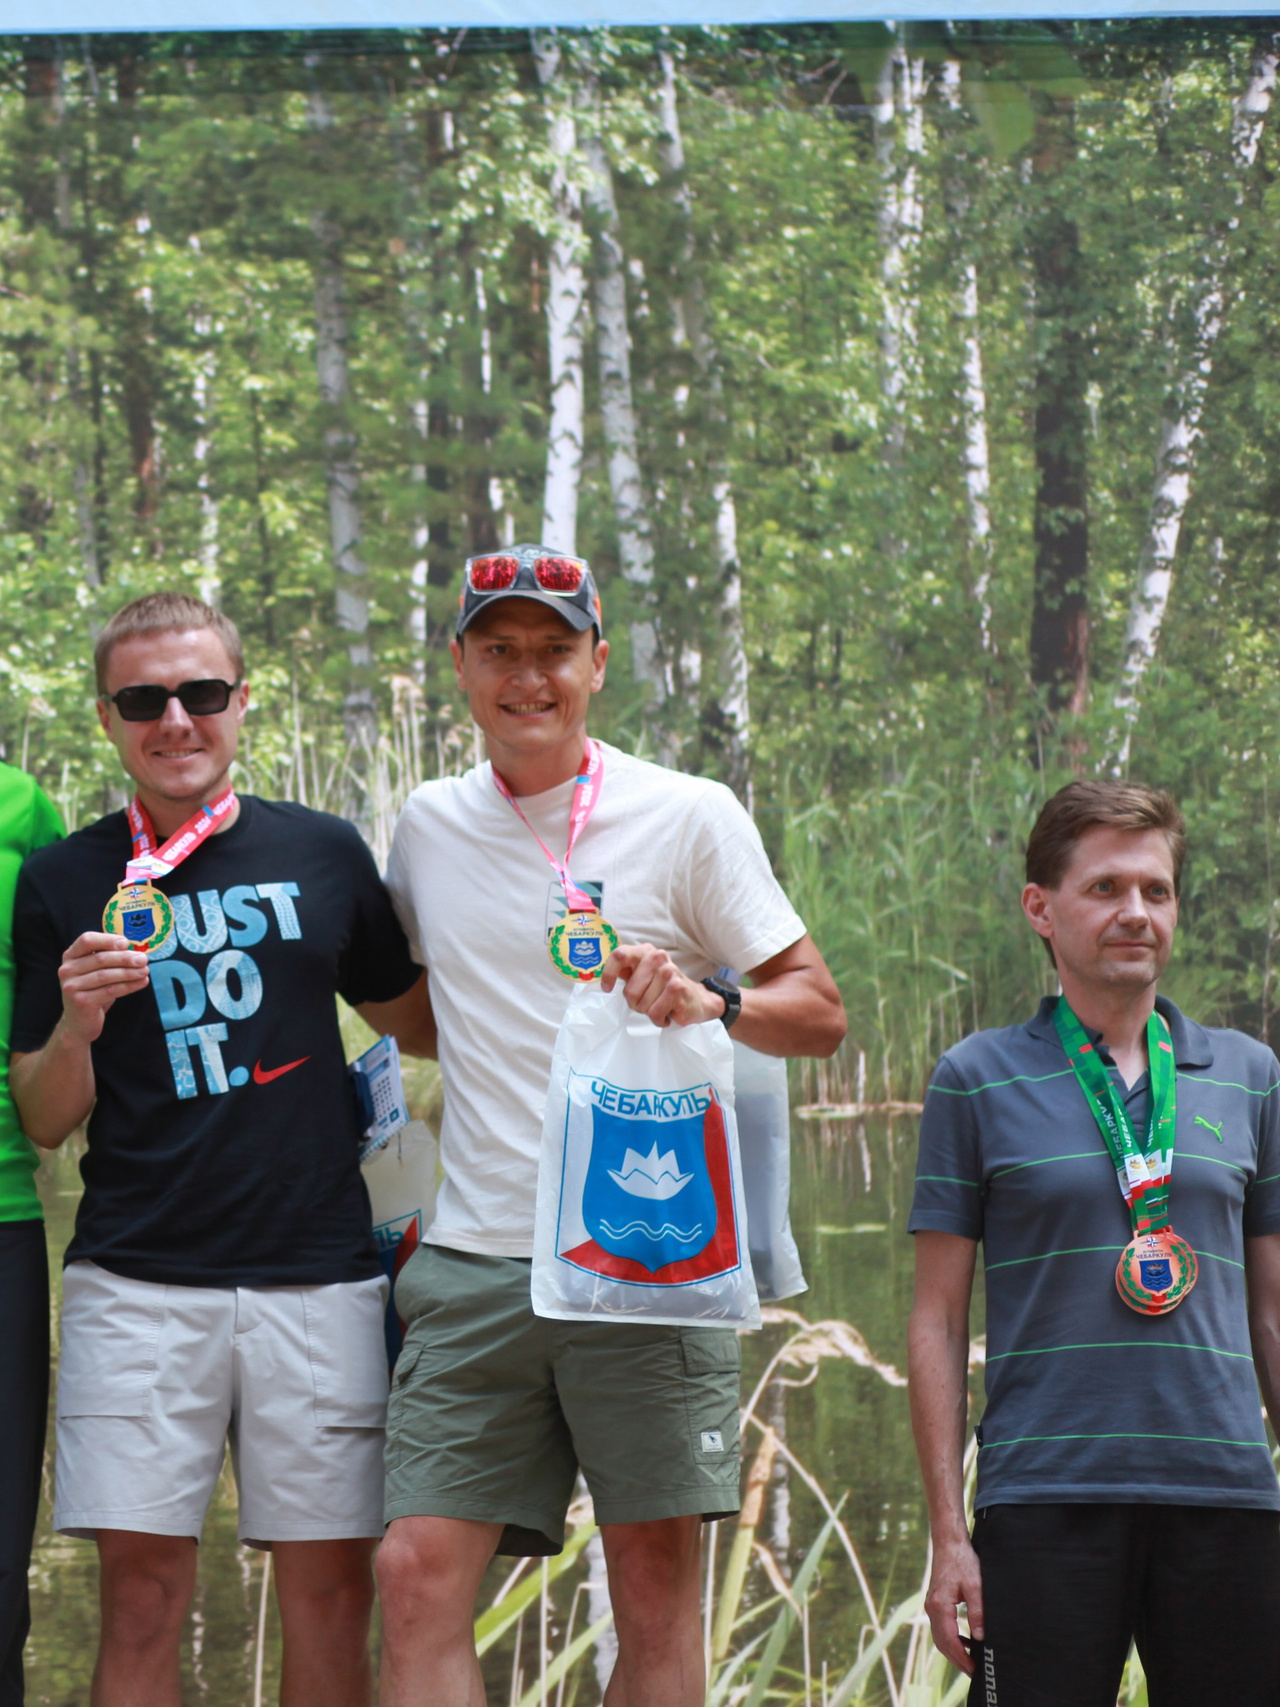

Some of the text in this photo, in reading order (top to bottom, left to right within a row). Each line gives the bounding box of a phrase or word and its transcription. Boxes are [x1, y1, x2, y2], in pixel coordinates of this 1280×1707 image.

[149, 949, 263, 1030] DO
[165, 1022, 250, 1100] IT.
[984, 1646, 998, 1707] nona
